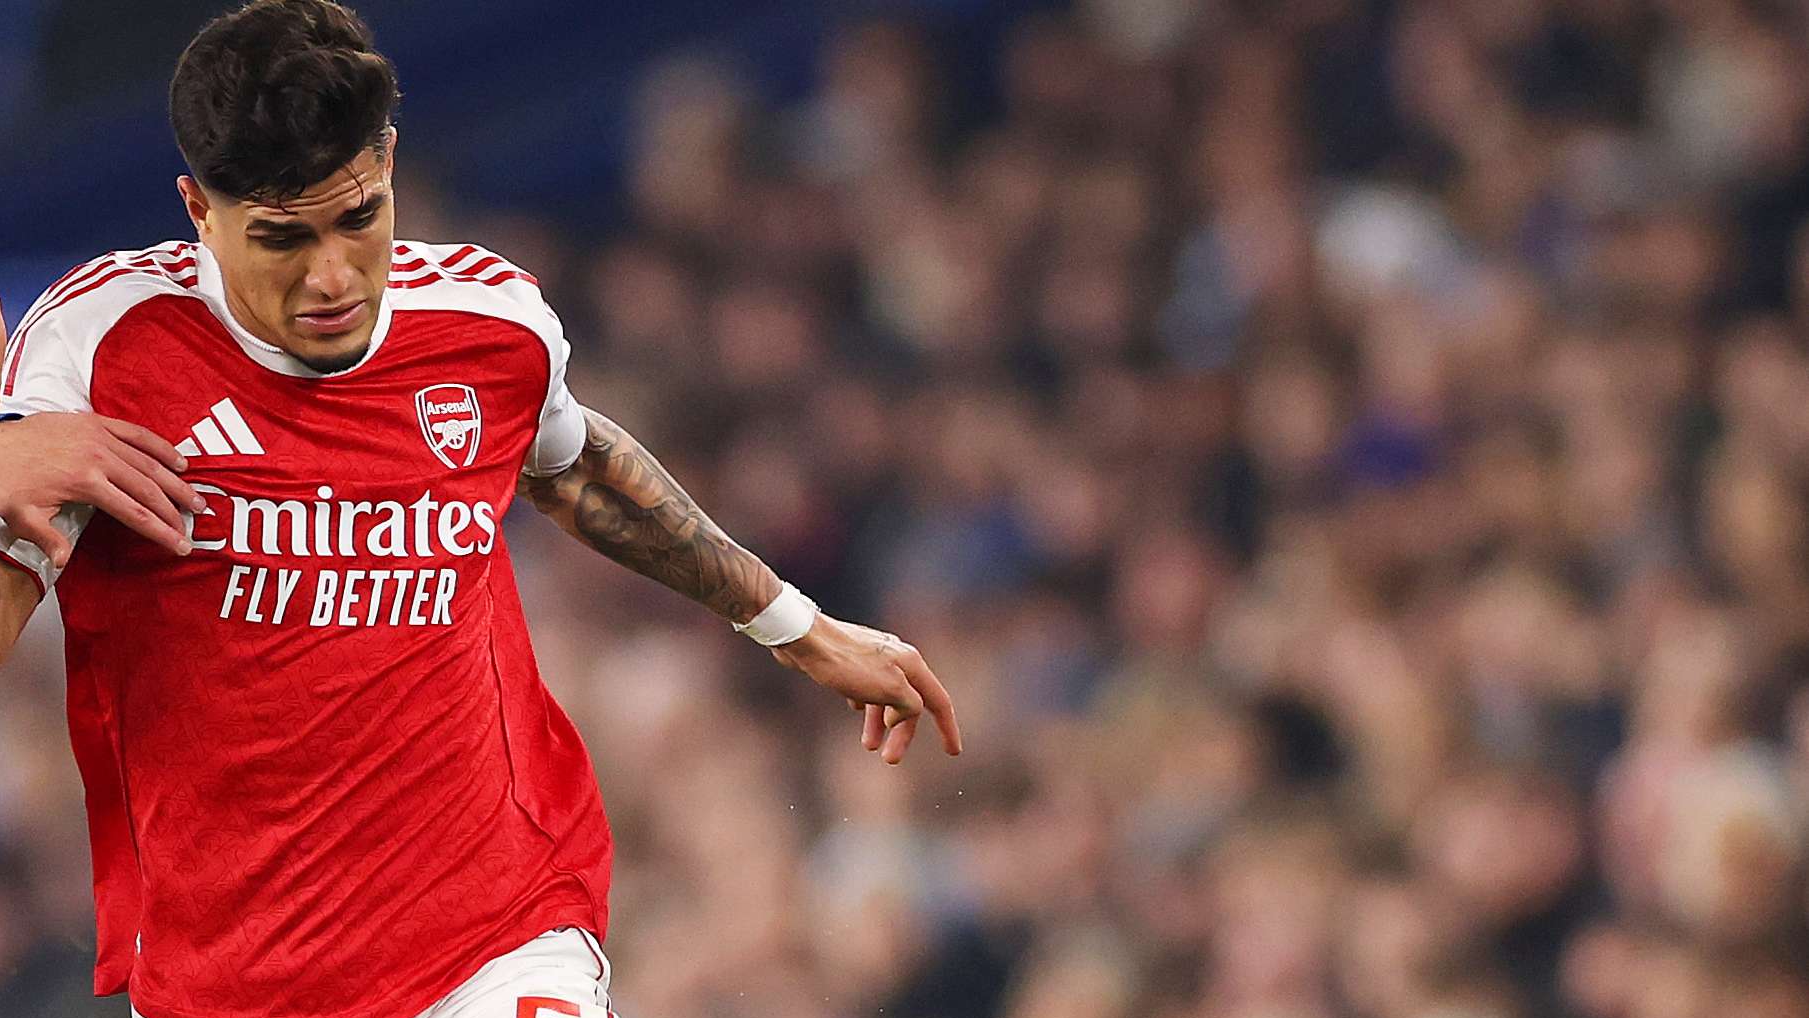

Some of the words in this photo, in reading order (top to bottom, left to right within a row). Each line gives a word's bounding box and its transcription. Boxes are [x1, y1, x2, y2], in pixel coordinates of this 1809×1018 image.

[426, 398, 471, 415] Arsenal
[182, 483, 495, 557] Emirates
[219, 565, 302, 625] FLY
[309, 568, 458, 627] BETTER
